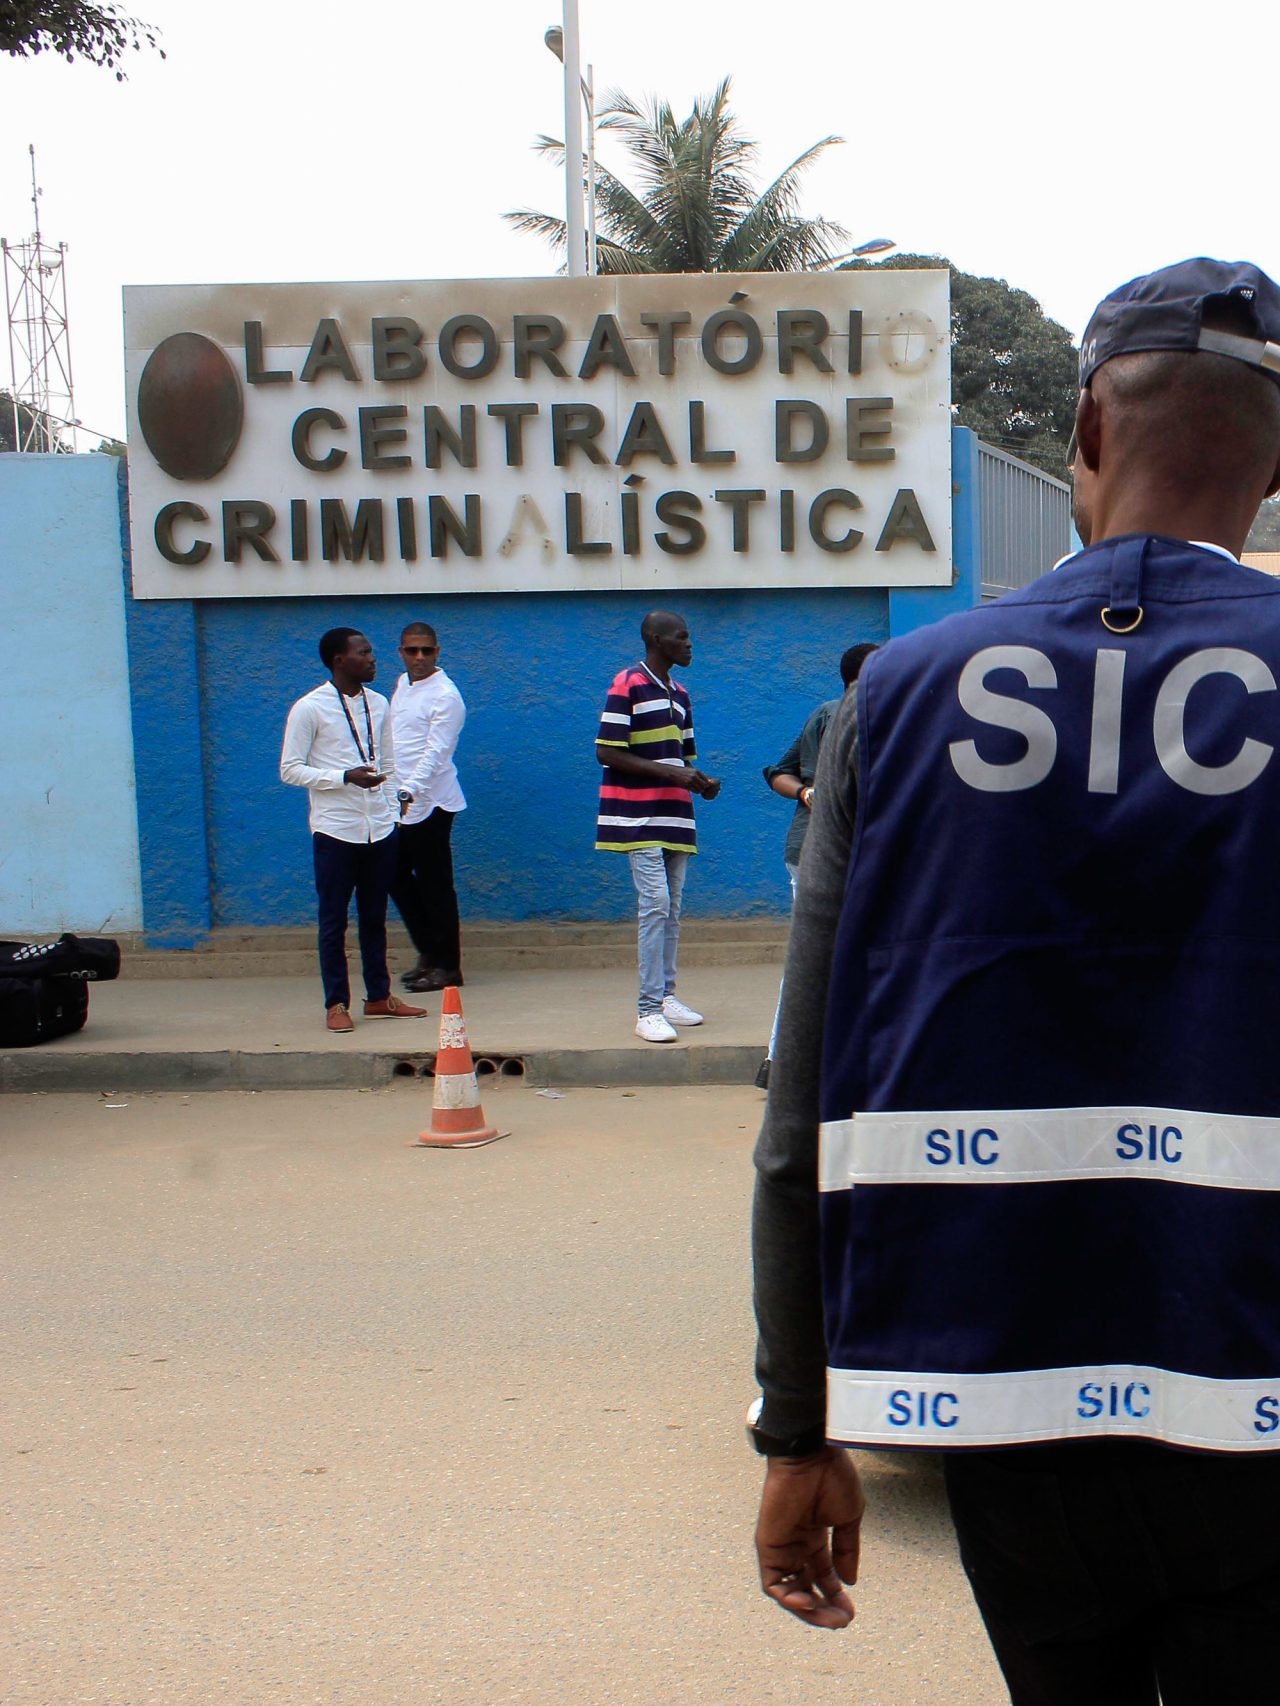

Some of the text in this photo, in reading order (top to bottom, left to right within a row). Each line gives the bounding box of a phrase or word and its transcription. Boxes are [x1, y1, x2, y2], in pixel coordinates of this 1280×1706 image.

[291, 396, 896, 472] CENTRAL DE
[949, 645, 1278, 796] SIC
[925, 1127, 1000, 1166] SIC
[1115, 1124, 1183, 1163] SIC
[887, 1389, 960, 1428] SIC
[1077, 1381, 1150, 1418] SIC
